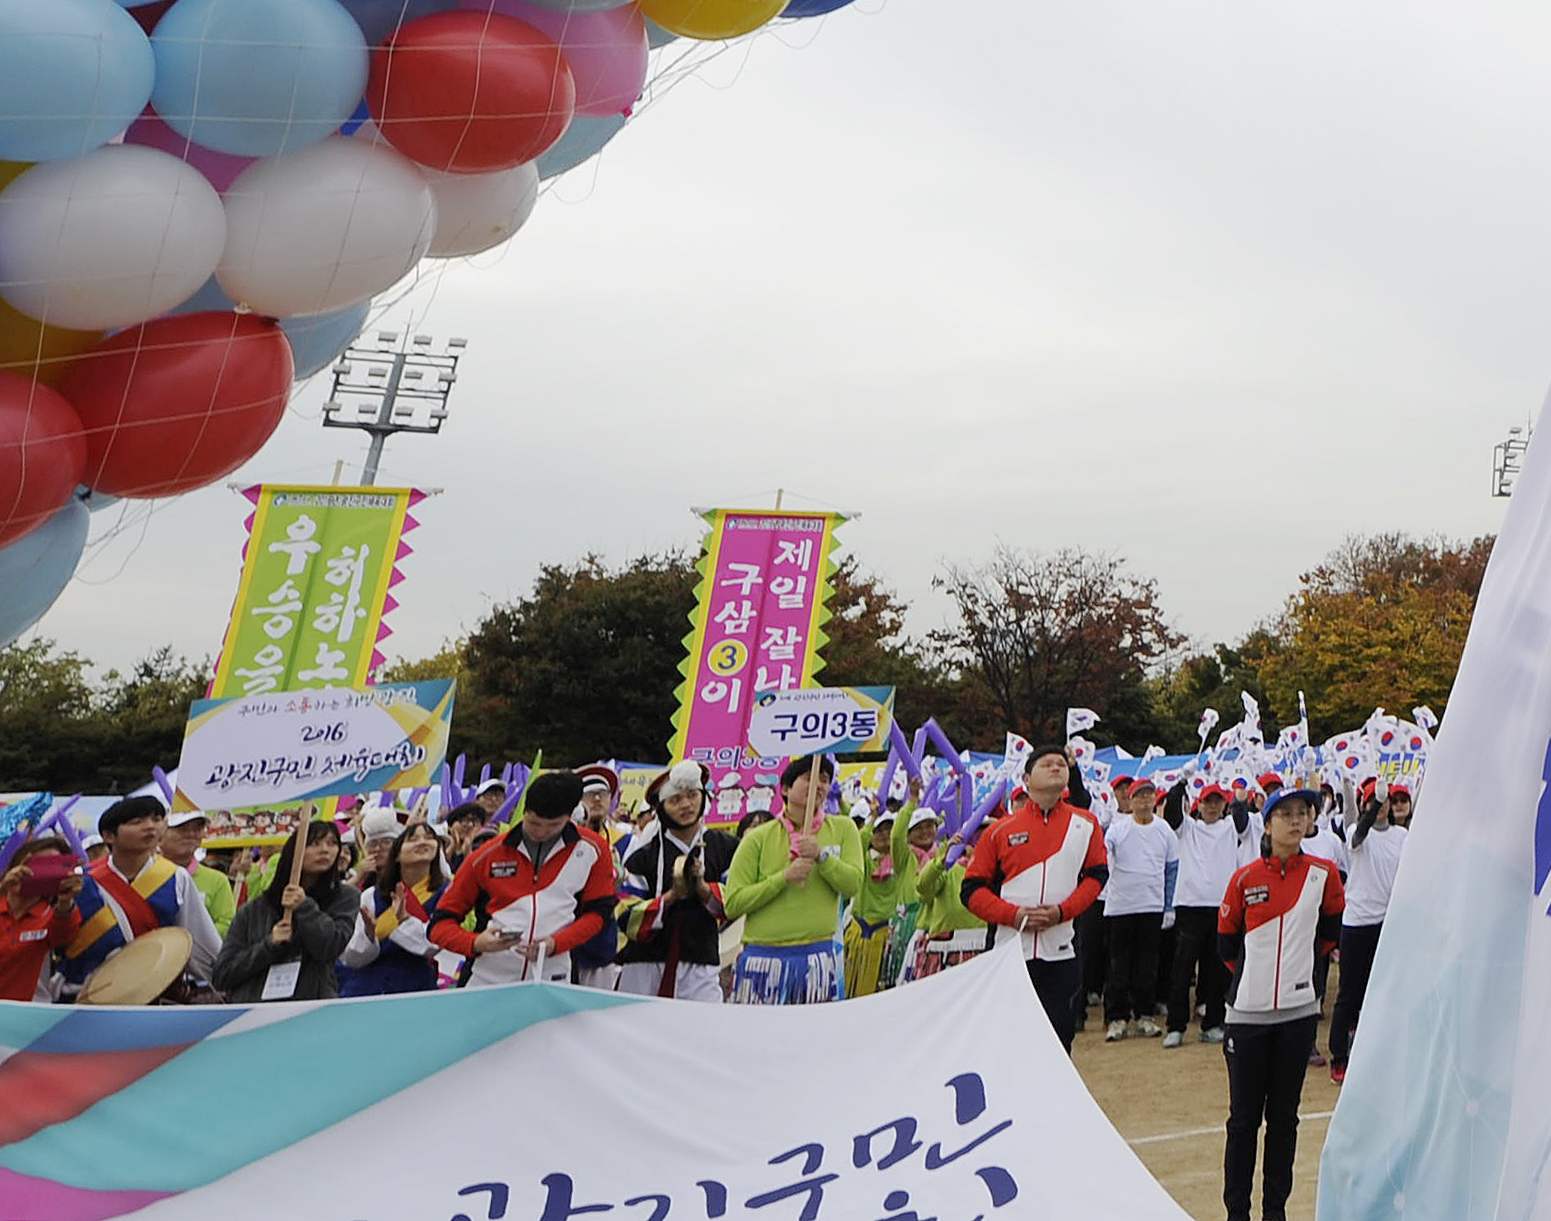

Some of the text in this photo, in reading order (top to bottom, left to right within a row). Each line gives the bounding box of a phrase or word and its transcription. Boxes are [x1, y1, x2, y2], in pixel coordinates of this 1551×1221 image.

[769, 537, 813, 610] 제일
[234, 514, 322, 694] 우승을
[298, 543, 370, 689] 허하노
[302, 722, 345, 742] 2016
[770, 710, 876, 741] 구의3동
[205, 746, 424, 788] 광진구민 체육대회
